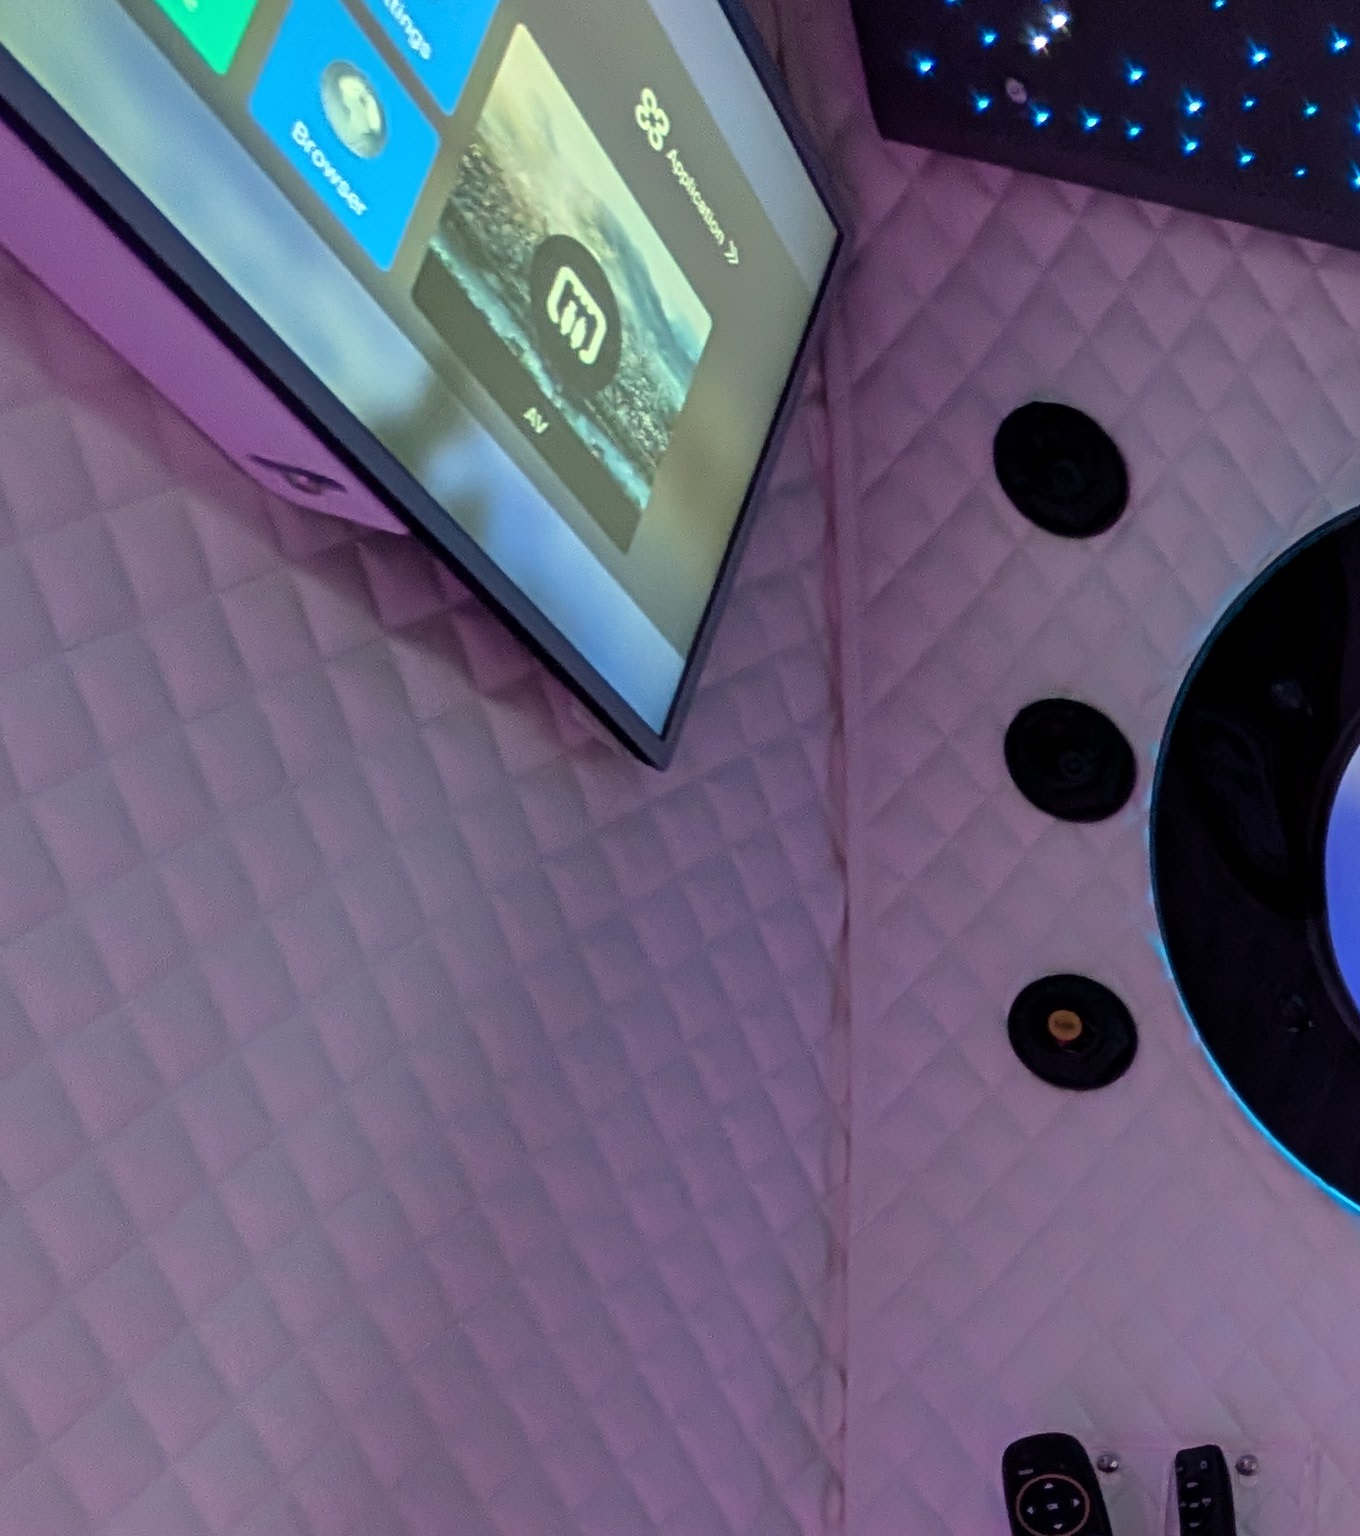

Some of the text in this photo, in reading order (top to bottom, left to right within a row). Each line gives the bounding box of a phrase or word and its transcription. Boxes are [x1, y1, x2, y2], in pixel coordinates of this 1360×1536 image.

[291, 120, 367, 216] Browser
[666, 149, 725, 245] Application
[523, 405, 549, 434] AV
